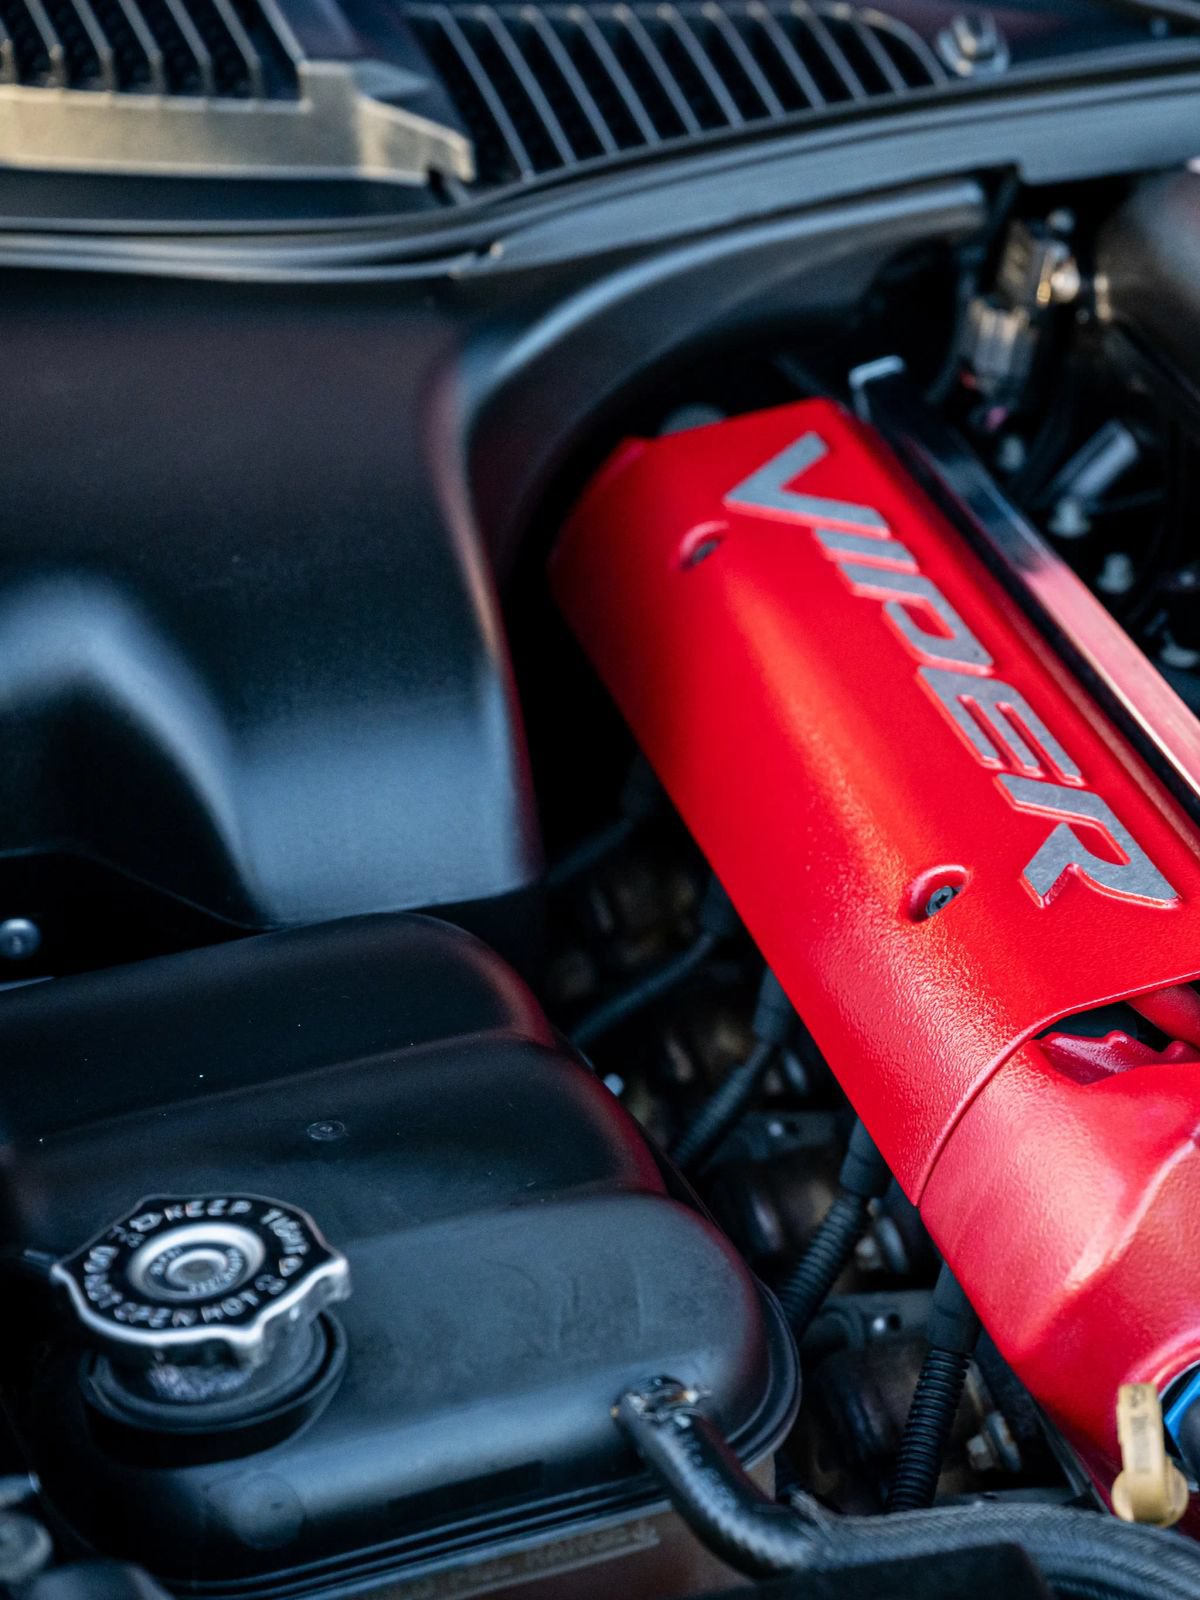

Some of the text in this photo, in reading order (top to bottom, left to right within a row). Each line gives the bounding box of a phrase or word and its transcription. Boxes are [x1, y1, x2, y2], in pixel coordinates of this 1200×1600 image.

[725, 430, 1181, 909] VIPER
[164, 1199, 252, 1221] KEEP
[200, 1289, 260, 1323] HOT
